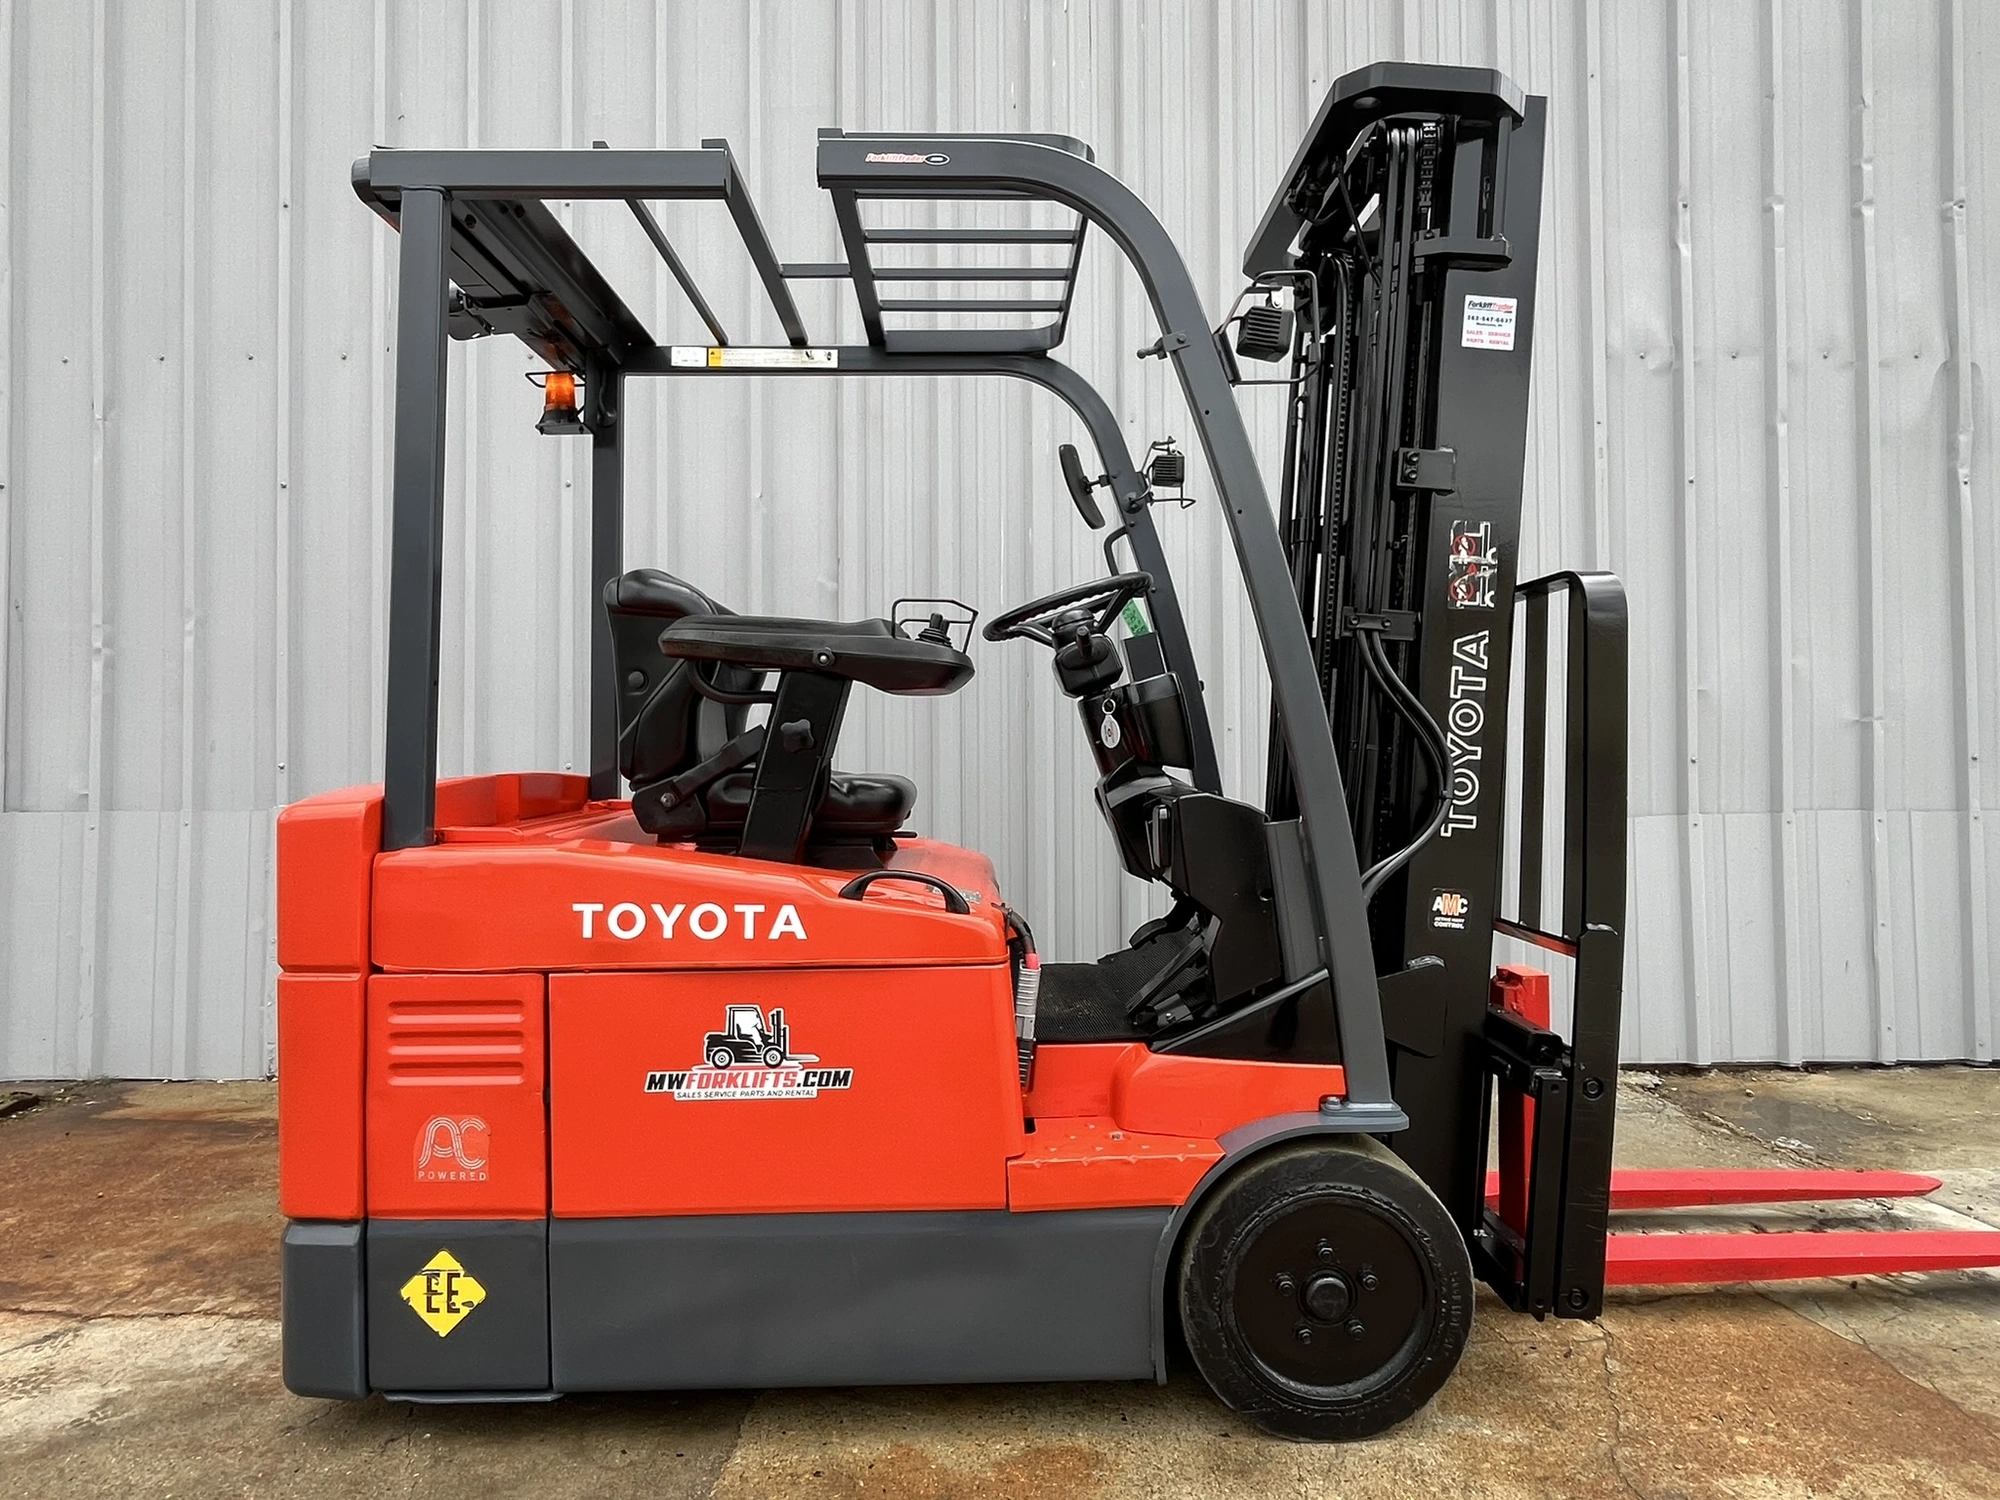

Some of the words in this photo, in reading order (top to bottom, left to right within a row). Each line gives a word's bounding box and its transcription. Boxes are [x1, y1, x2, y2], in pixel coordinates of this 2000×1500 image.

[1440, 630, 1490, 837] TOYOTA
[1431, 893, 1469, 917] AMC
[571, 902, 809, 940] TOYOTA
[1433, 921, 1466, 930] CONTROL
[646, 1070, 852, 1091] MWFORKLIFTS.COM
[676, 1091, 702, 1099] SALES
[704, 1090, 737, 1099] SERVICE
[766, 1089, 784, 1097] AND
[785, 1088, 816, 1096] RENTAL
[418, 1116, 486, 1170] AC
[418, 1171, 487, 1181] POWERED
[426, 1272, 461, 1314] EE
